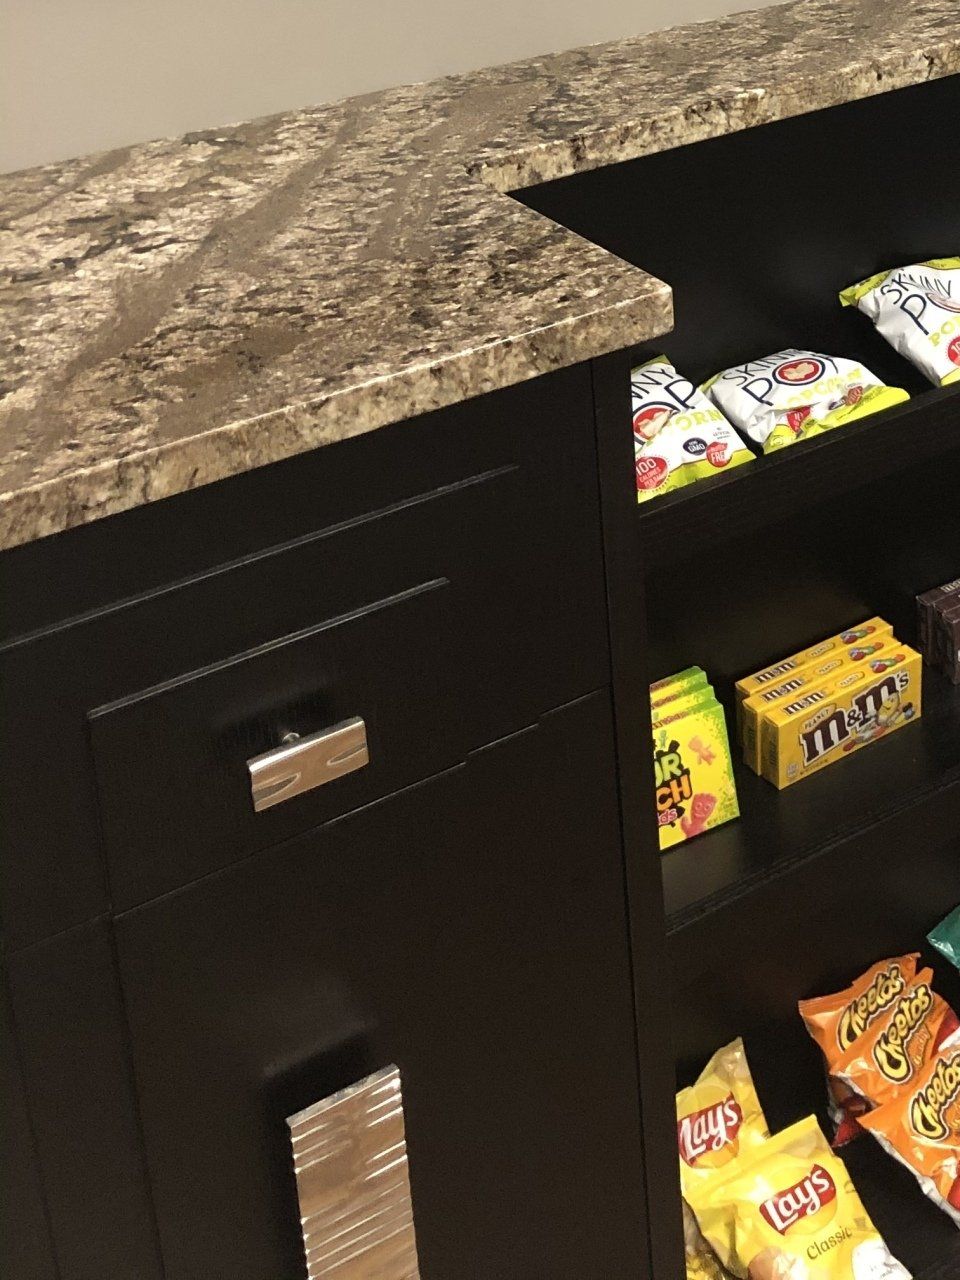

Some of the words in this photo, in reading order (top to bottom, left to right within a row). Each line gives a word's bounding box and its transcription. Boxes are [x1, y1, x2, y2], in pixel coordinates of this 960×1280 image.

[837, 966, 904, 1051] Cheetos
[874, 984, 932, 1081] Cheetos
[805, 1225, 853, 1260] Classic
